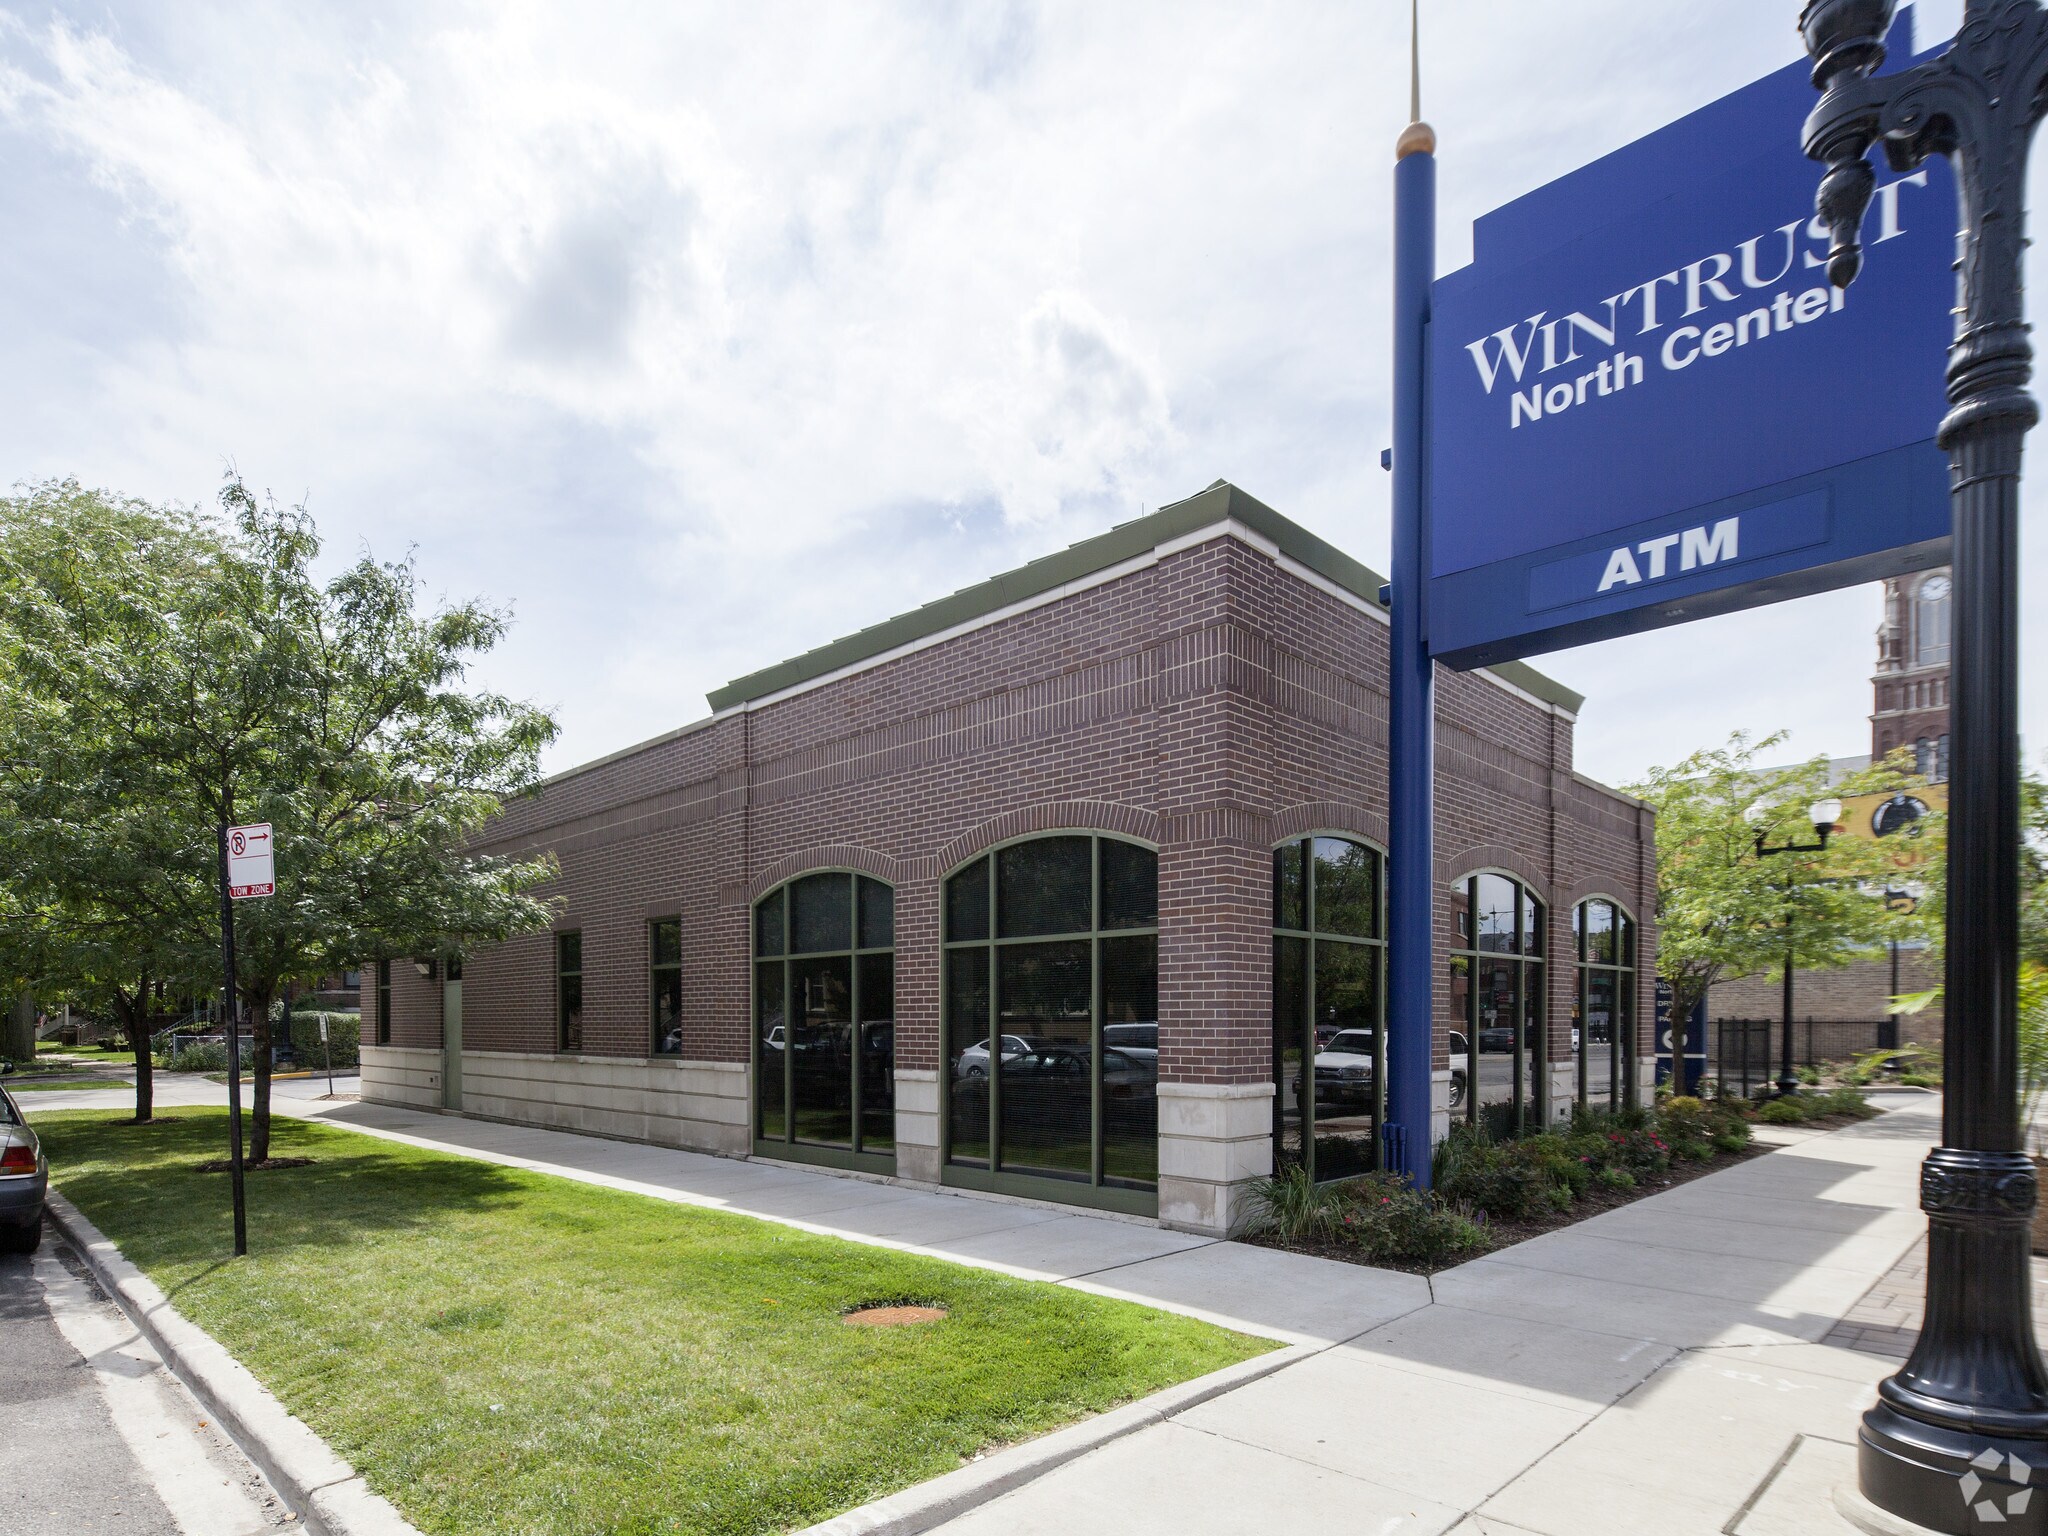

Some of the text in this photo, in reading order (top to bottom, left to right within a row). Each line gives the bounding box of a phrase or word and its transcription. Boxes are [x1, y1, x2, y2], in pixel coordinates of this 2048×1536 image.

[1511, 352, 1644, 429] North
[1597, 517, 1739, 592] ATM
[232, 884, 270, 896] TOW ZONE
